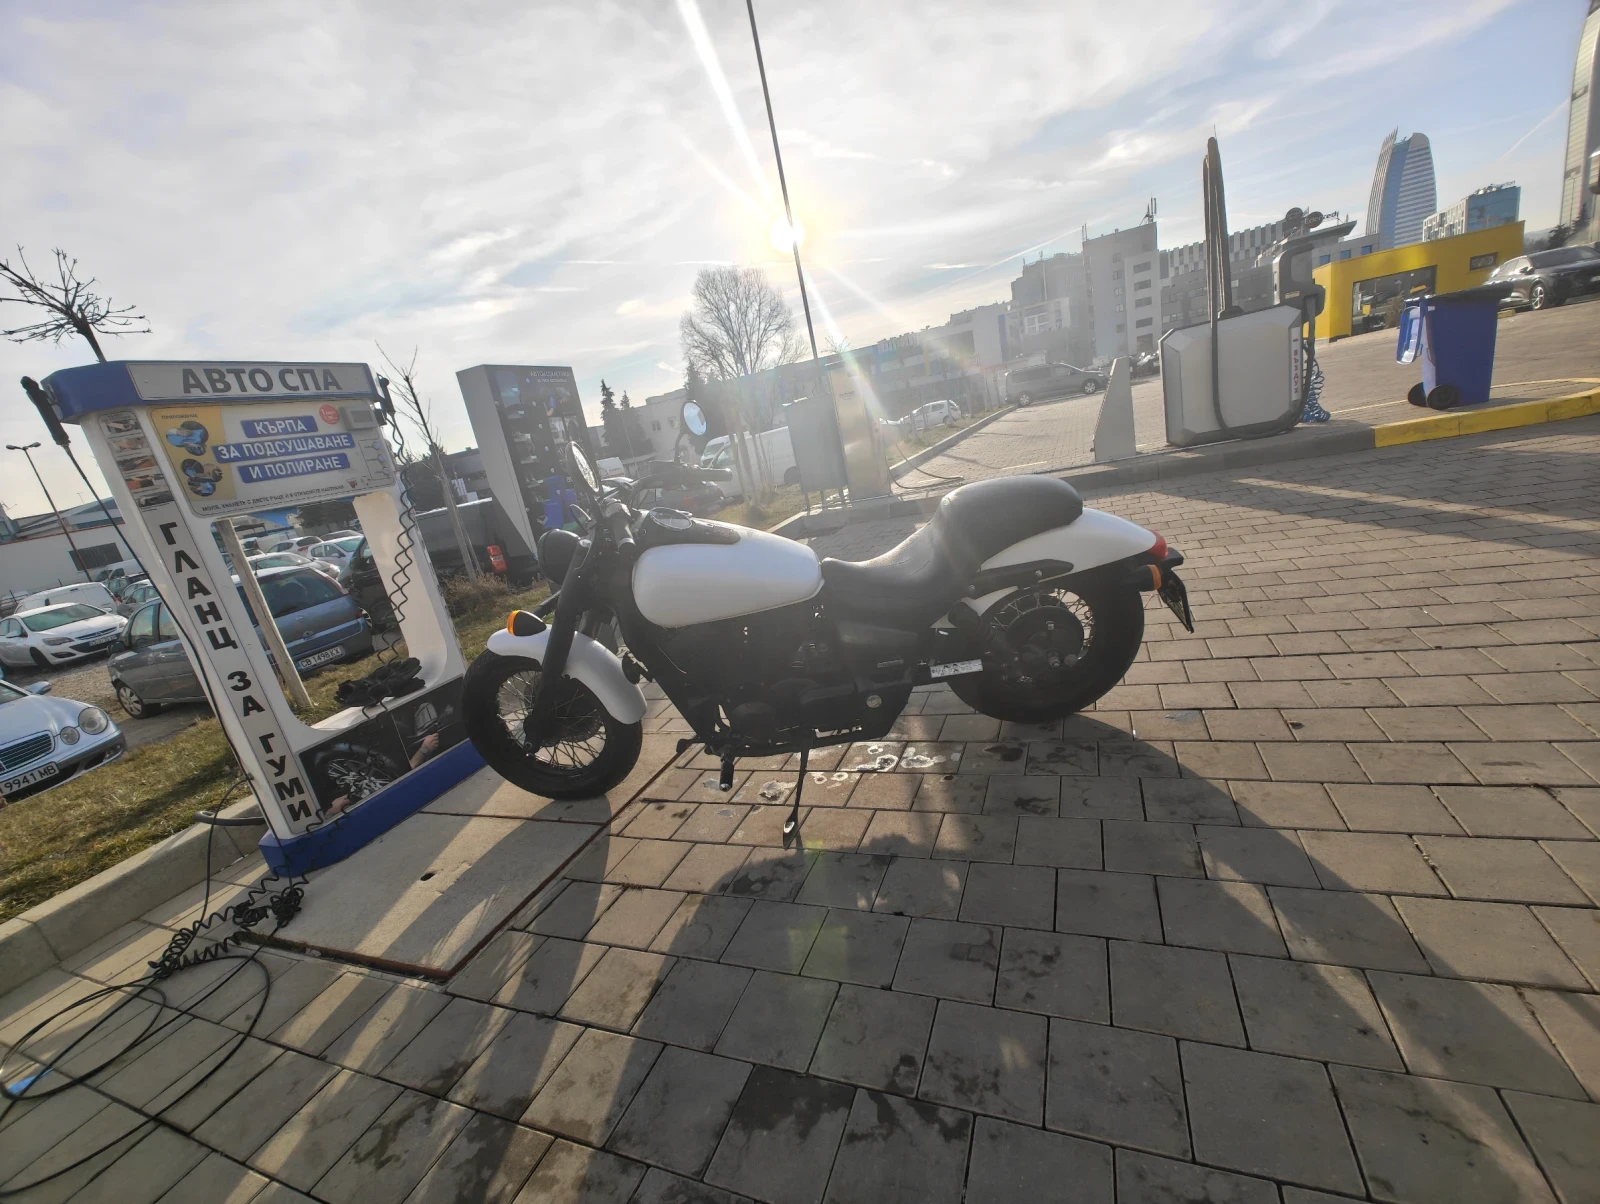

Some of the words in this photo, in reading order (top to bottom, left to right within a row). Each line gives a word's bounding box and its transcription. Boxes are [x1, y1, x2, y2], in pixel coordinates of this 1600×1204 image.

[182, 368, 274, 394] АВТО
[278, 368, 342, 392] СПА
[1292, 349, 1300, 394] ВЪЗДУХ
[254, 419, 307, 436] КЪРПА
[217, 445, 242, 460] ЗА
[244, 434, 351, 457] ПОДСУШАВАНЕ
[249, 466, 260, 480] И
[265, 456, 342, 477] ПОЛИРАНЕ
[159, 521, 239, 651] ГЛАНЦ
[312, 651, 330, 663] 1498
[227, 669, 265, 718] ЗА
[39, 765, 56, 778] MB
[258, 732, 313, 823] ГУМИ
